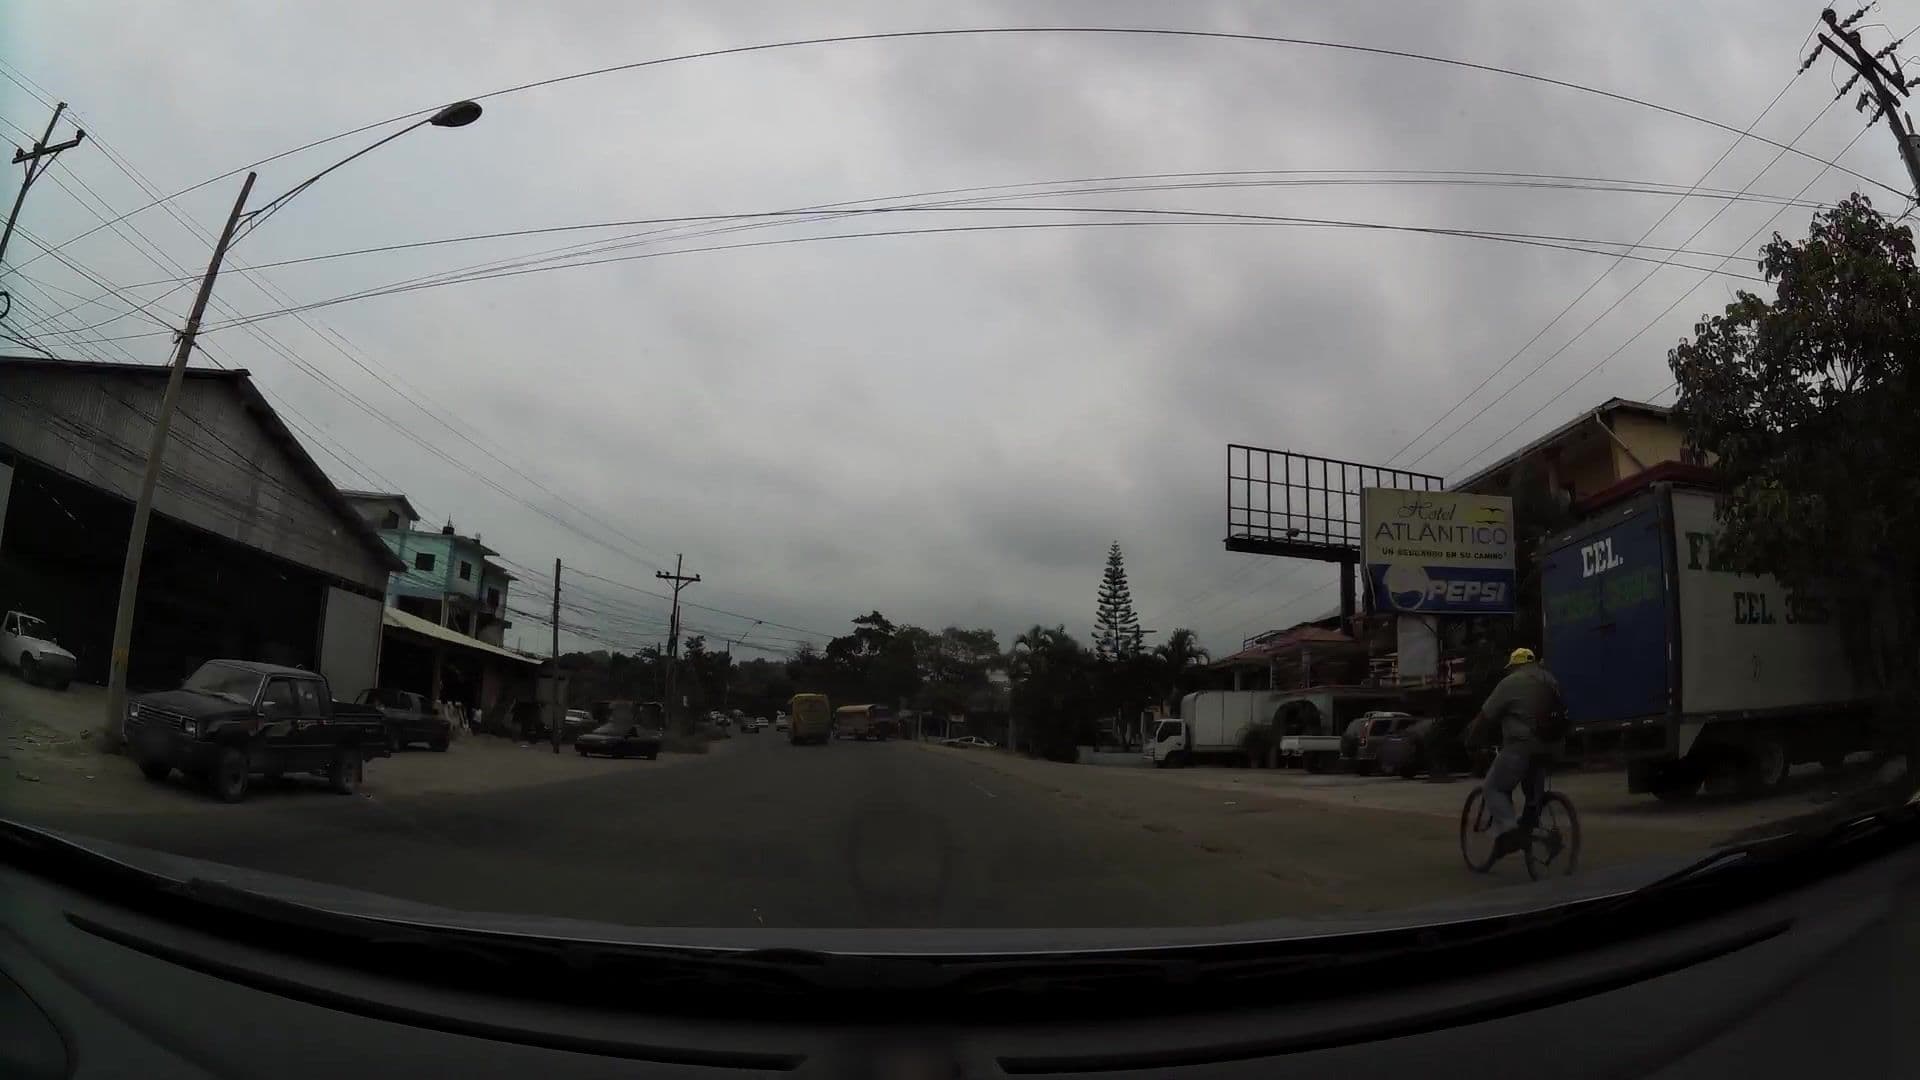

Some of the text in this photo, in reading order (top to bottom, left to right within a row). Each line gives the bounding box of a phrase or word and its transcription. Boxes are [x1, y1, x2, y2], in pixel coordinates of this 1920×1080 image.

[1397, 501, 1457, 521] Hotel
[1375, 521, 1508, 545] ATLANTICO
[1382, 547, 1394, 556] UN
[1445, 551, 1457, 559] EN
[1459, 551, 1471, 559] SU
[1581, 537, 1624, 578] CEL.
[1427, 579, 1507, 602] PEPSI
[1734, 591, 1776, 625] CEL.
